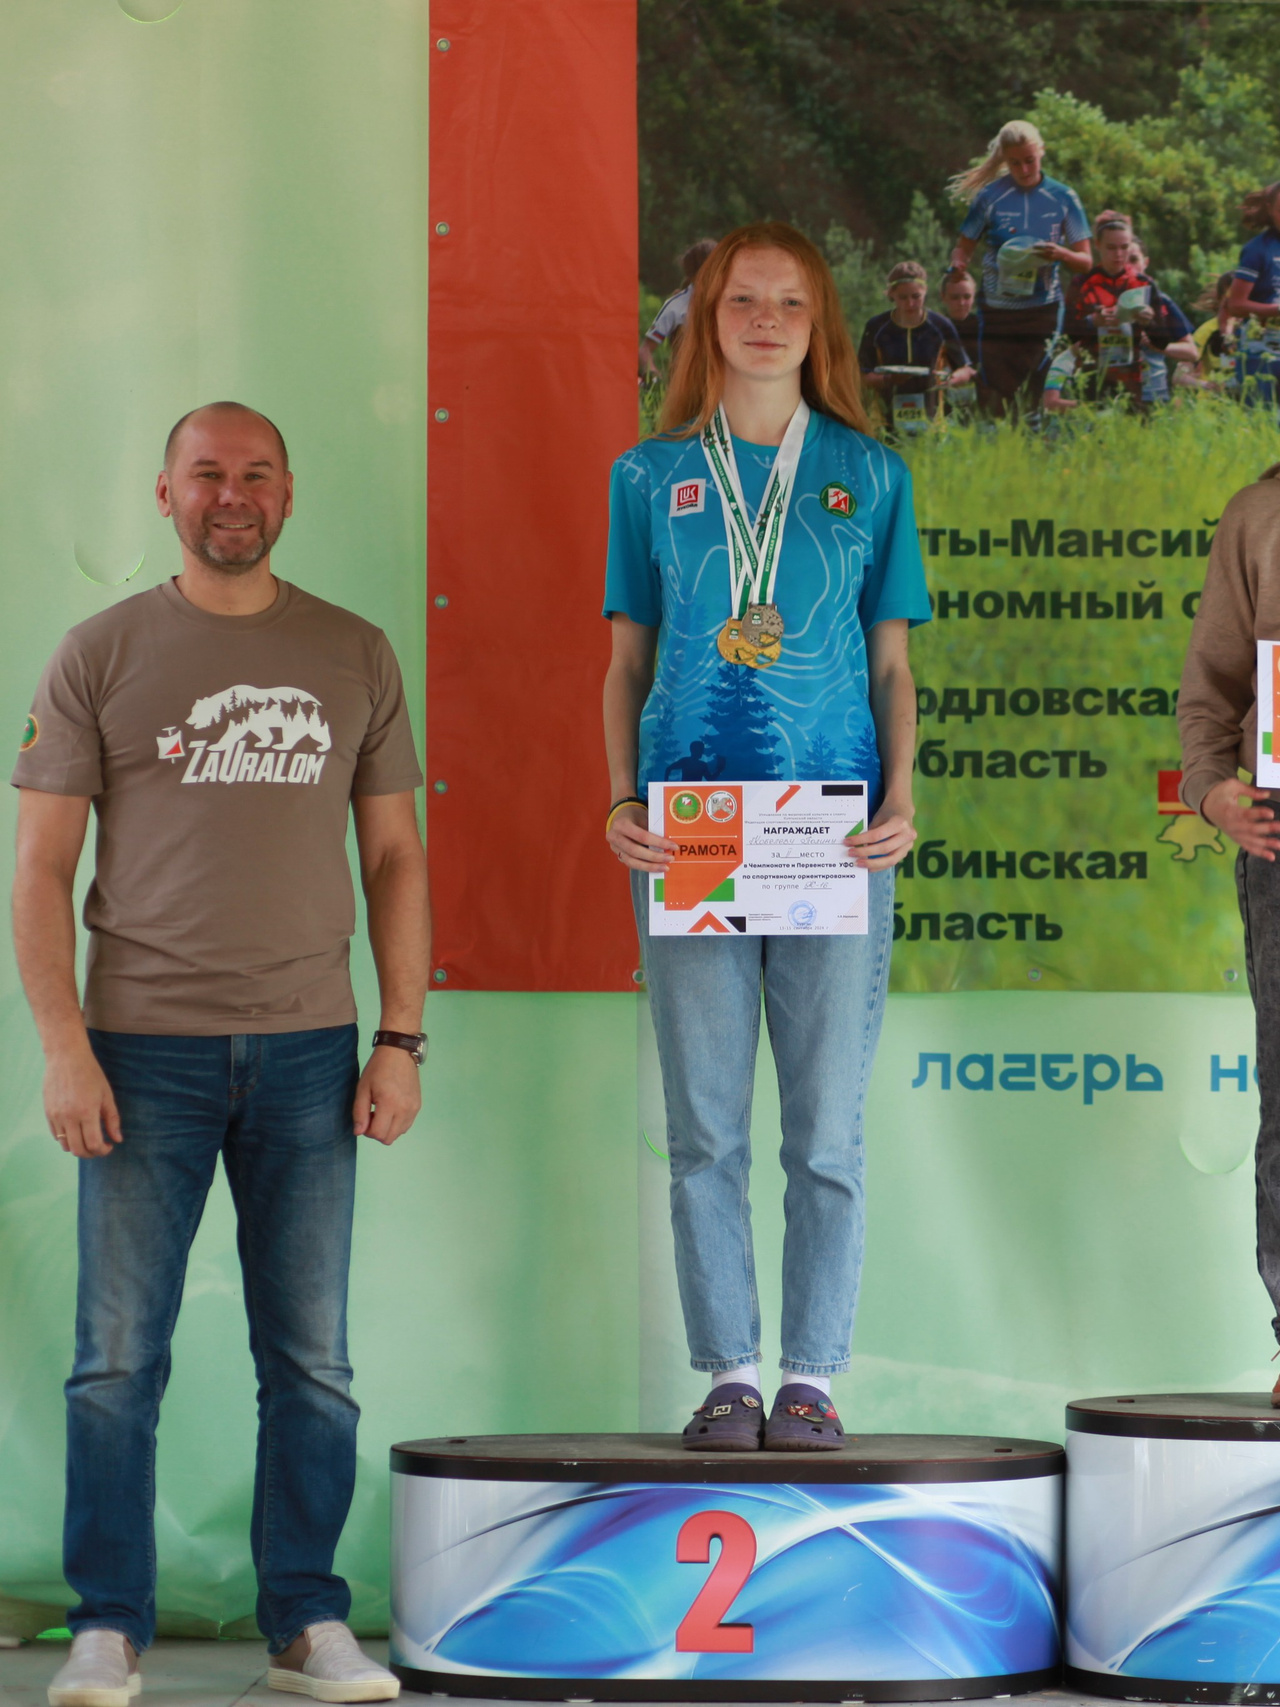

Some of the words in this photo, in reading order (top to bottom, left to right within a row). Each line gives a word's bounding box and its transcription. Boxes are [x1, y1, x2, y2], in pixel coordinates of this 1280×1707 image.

[928, 580, 1162, 619] номный
[916, 687, 1179, 725] рдловска
[181, 740, 326, 784] ZAURALOM
[912, 739, 1107, 778] бласть
[763, 826, 831, 835] НАГРАЖДАЕТ
[675, 1509, 758, 1653] 2
